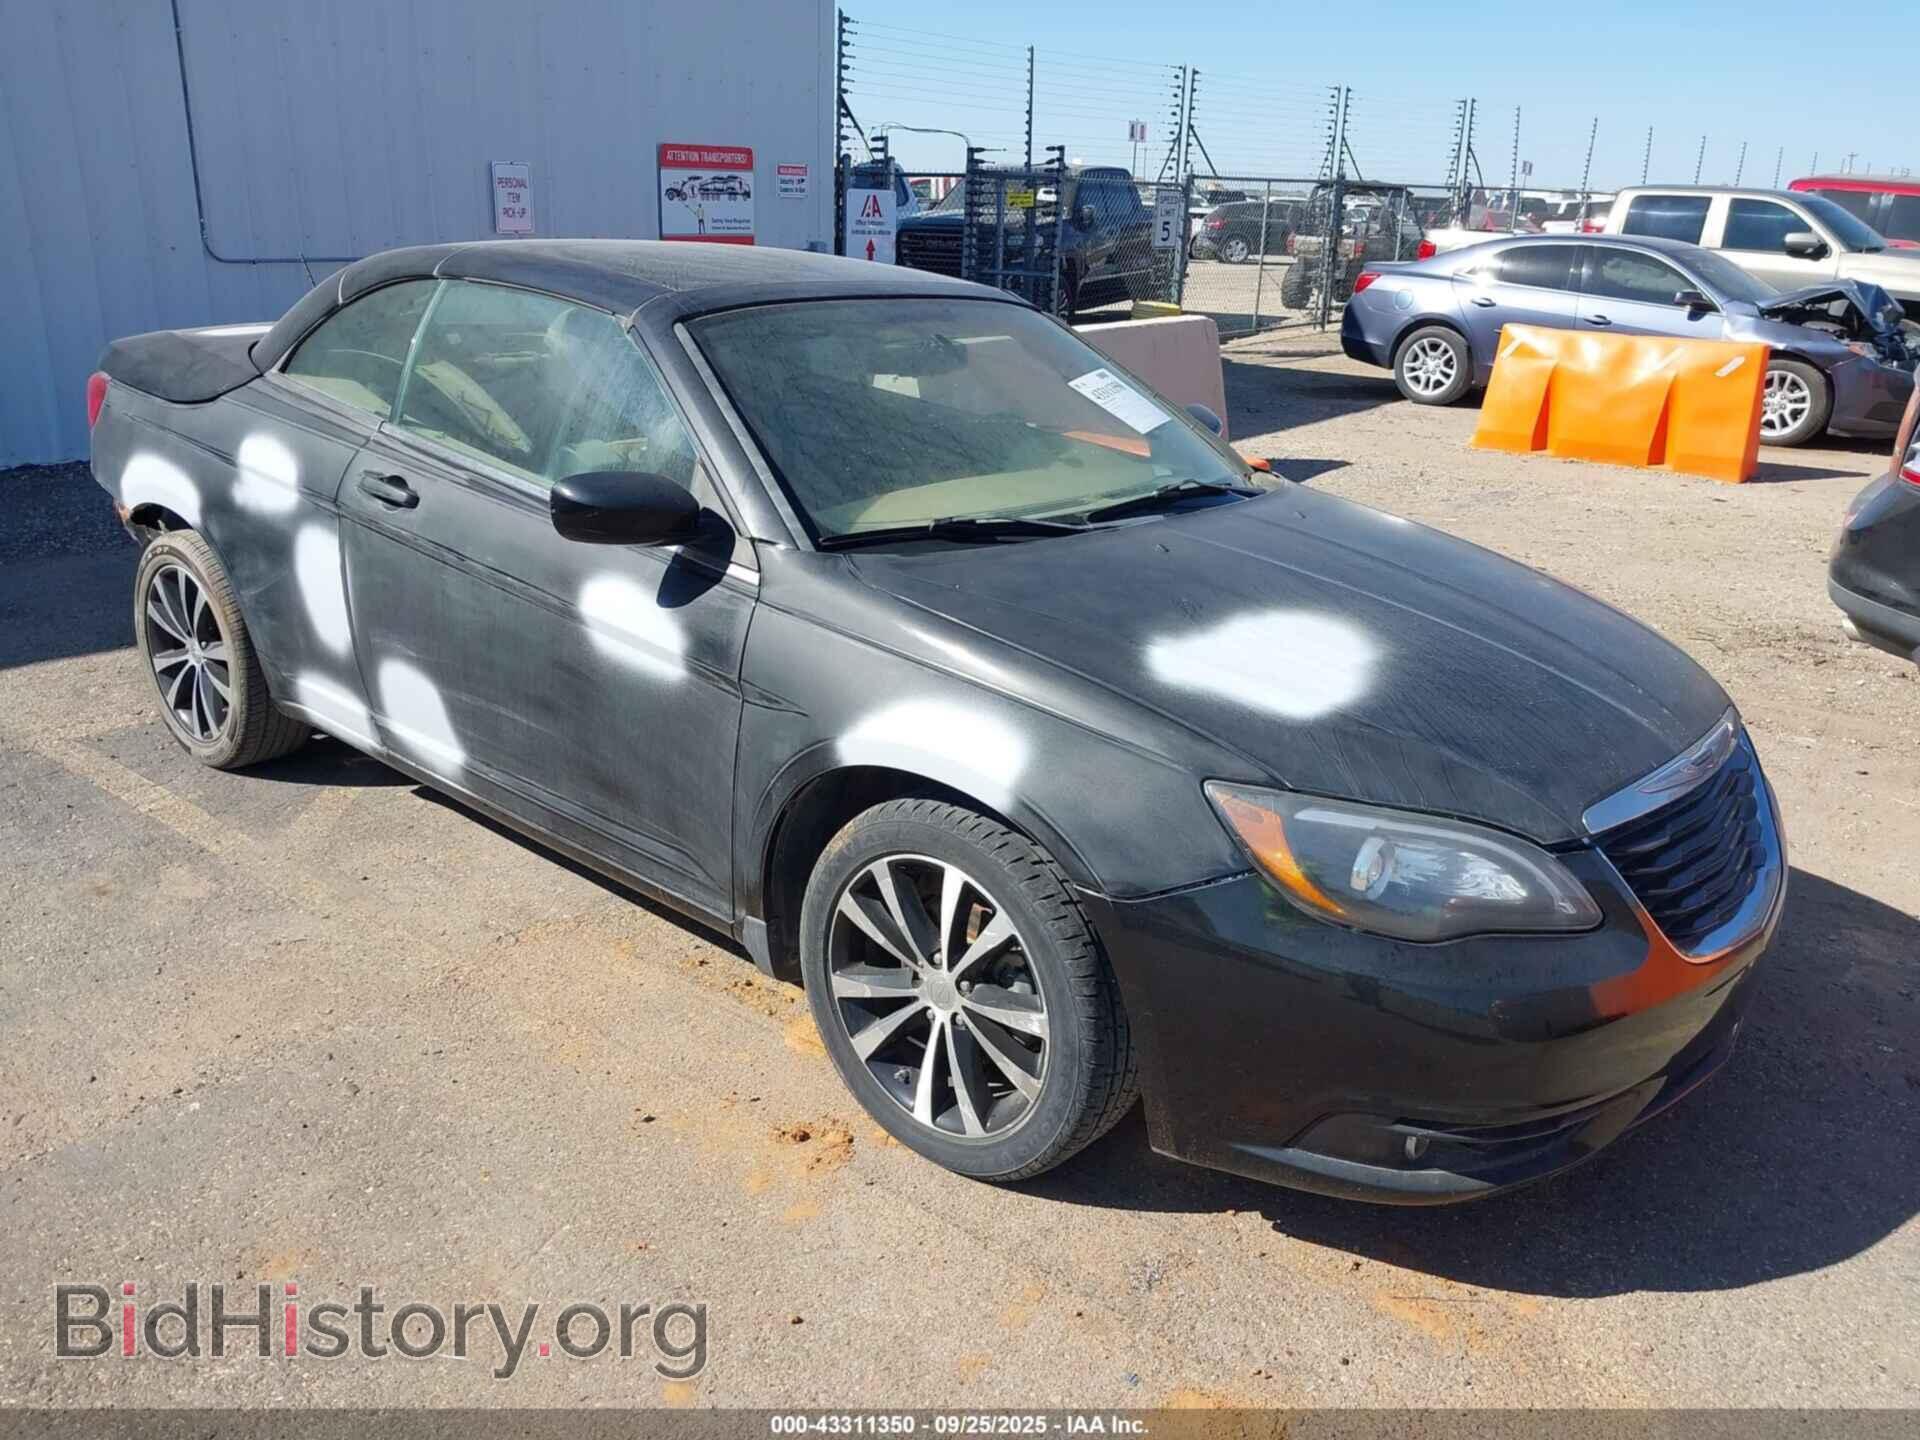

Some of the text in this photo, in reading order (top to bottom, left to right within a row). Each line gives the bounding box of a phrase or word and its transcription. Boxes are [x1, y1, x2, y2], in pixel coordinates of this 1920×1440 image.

[666, 150, 699, 162] ATTENTION
[497, 176, 528, 189] PERSONAL
[1161, 221, 1171, 241] 5
